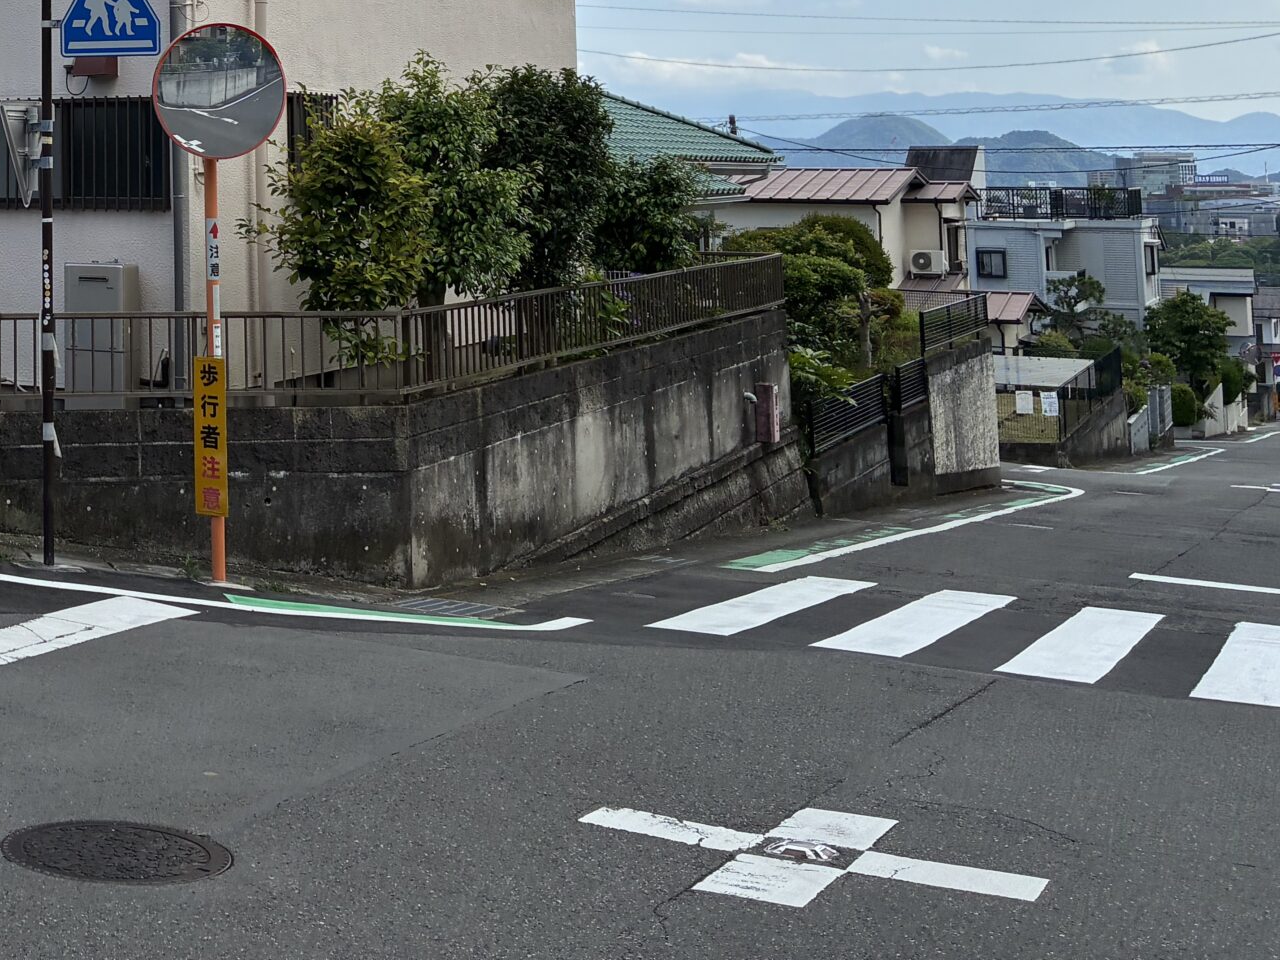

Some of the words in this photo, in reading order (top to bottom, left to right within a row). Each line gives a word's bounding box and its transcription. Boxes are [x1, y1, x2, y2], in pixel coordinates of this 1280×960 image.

[209, 244, 220, 277] 注意
[200, 363, 221, 510] 歩行者注意
